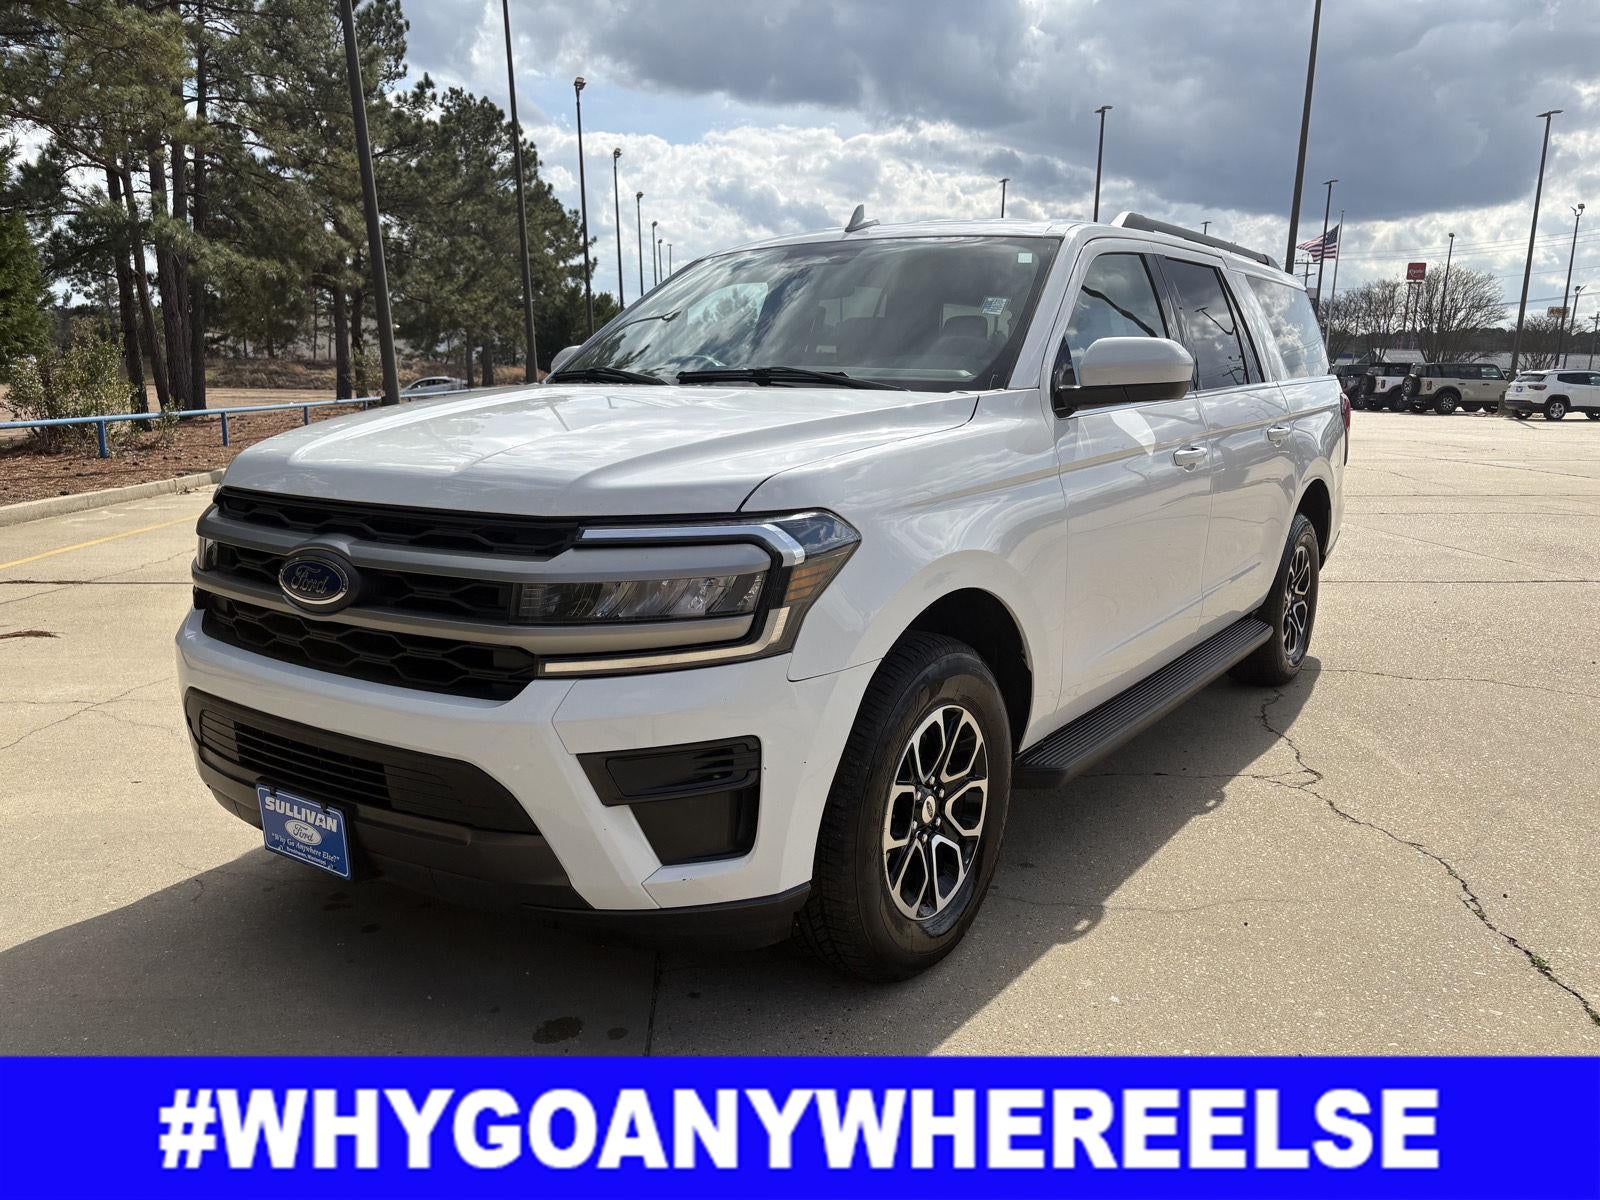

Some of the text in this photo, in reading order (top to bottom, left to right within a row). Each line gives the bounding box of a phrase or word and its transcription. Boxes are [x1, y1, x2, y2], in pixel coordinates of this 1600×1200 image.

[291, 565, 330, 594] Ford
[265, 796, 337, 832] SULLIVAN
[293, 823, 314, 842] Ford
[287, 838, 295, 847] Go
[296, 842, 321, 857] Anywhere
